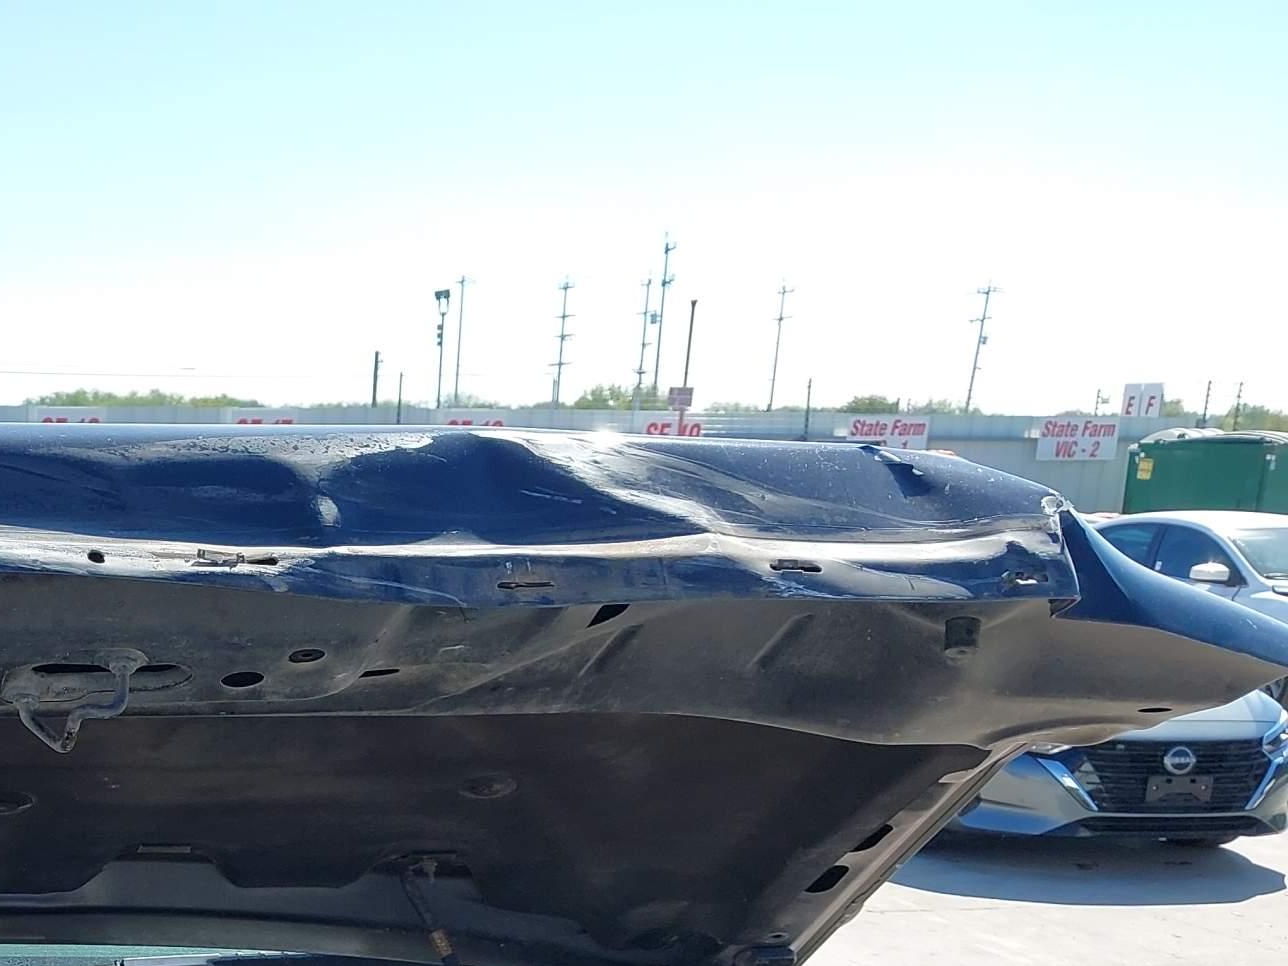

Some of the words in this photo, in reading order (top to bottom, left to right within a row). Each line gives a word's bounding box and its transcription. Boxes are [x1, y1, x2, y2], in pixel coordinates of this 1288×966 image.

[1125, 395, 1136, 416] E
[1145, 395, 1157, 416] F
[850, 419, 888, 437] State
[890, 419, 927, 437] Farm
[1041, 420, 1080, 438] State
[1082, 420, 1117, 438] Farm
[1055, 440, 1079, 458] VIC
[1089, 440, 1101, 458] 2
